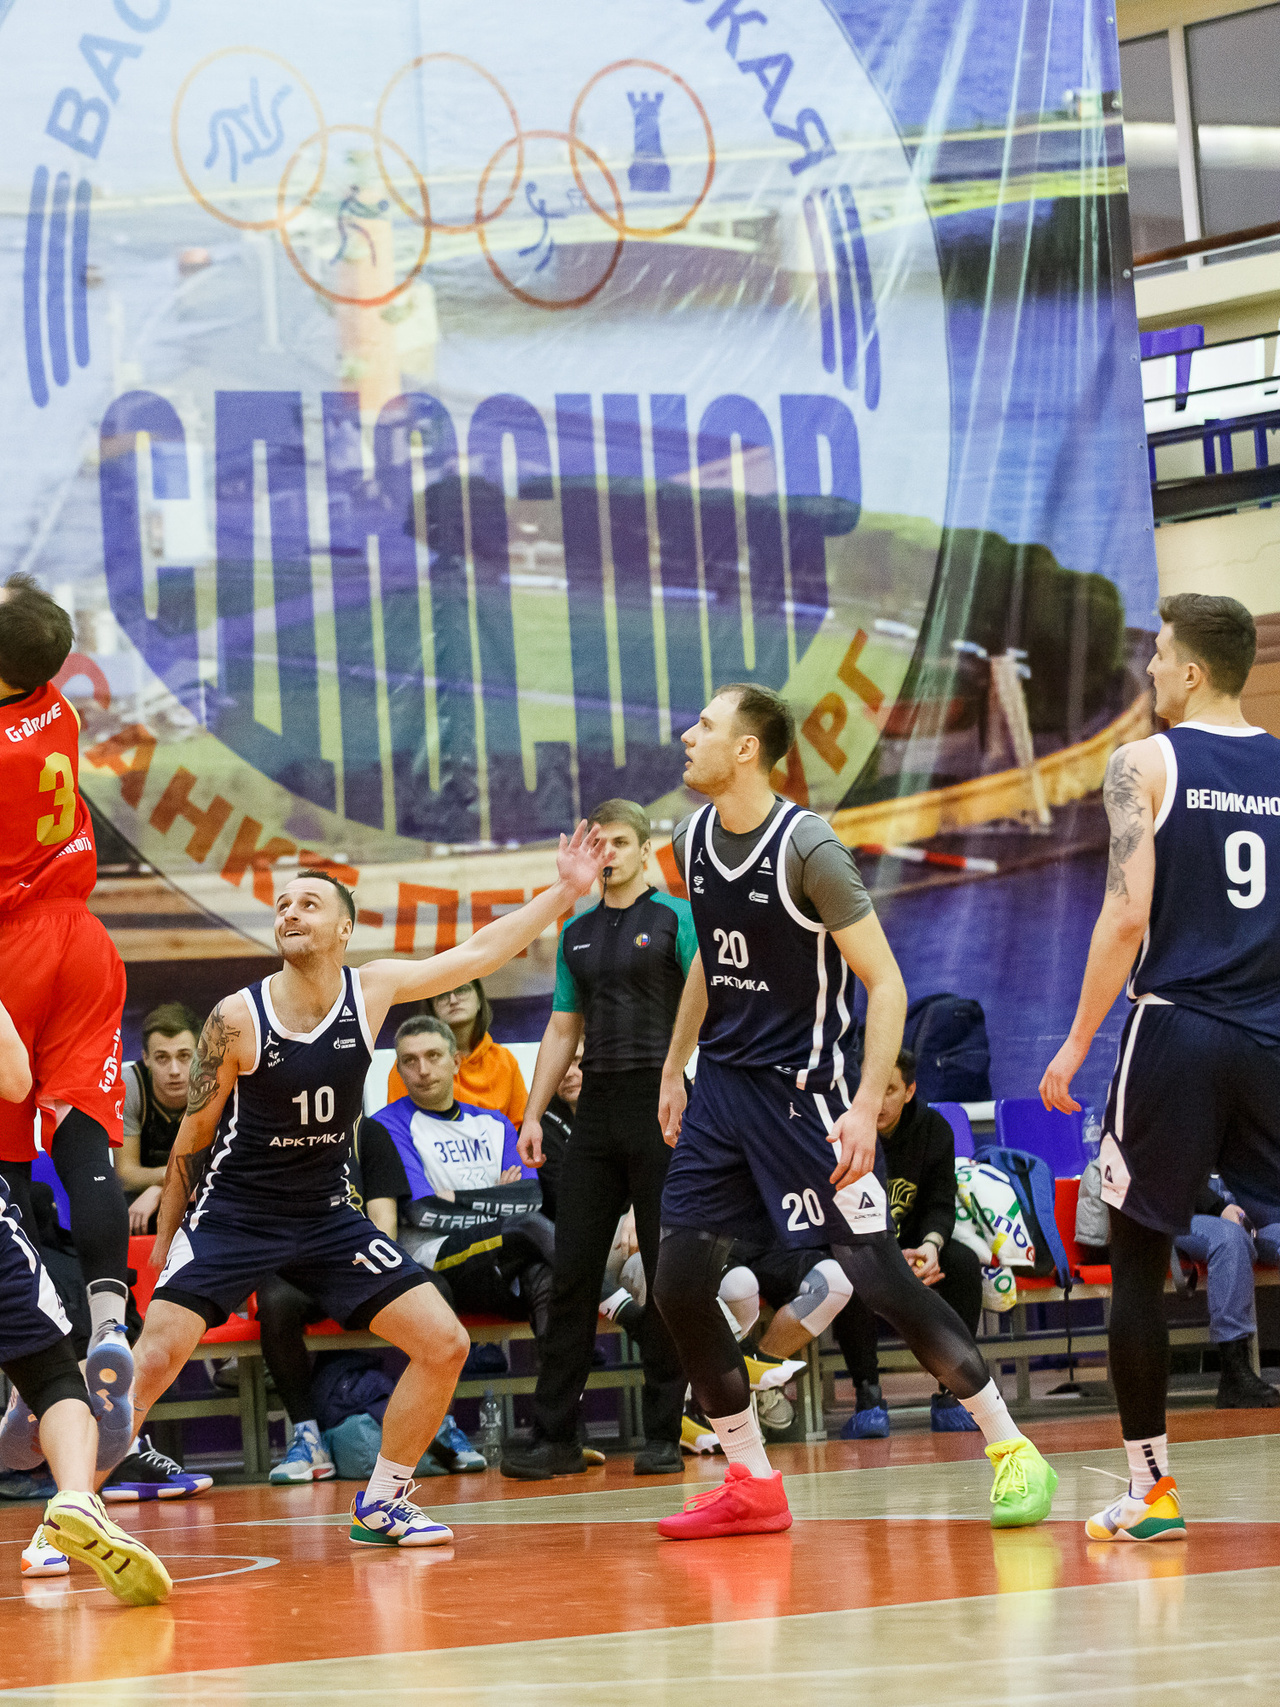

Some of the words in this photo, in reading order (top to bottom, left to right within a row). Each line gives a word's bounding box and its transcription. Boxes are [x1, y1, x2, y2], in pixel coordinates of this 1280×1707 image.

[37, 752, 76, 846] 3
[1225, 830, 1266, 909] 9
[713, 928, 749, 969] 20
[292, 1085, 335, 1125] 10
[269, 1132, 345, 1148] АРКТИКА
[781, 1188, 825, 1231] 20
[351, 1238, 403, 1275] 10
